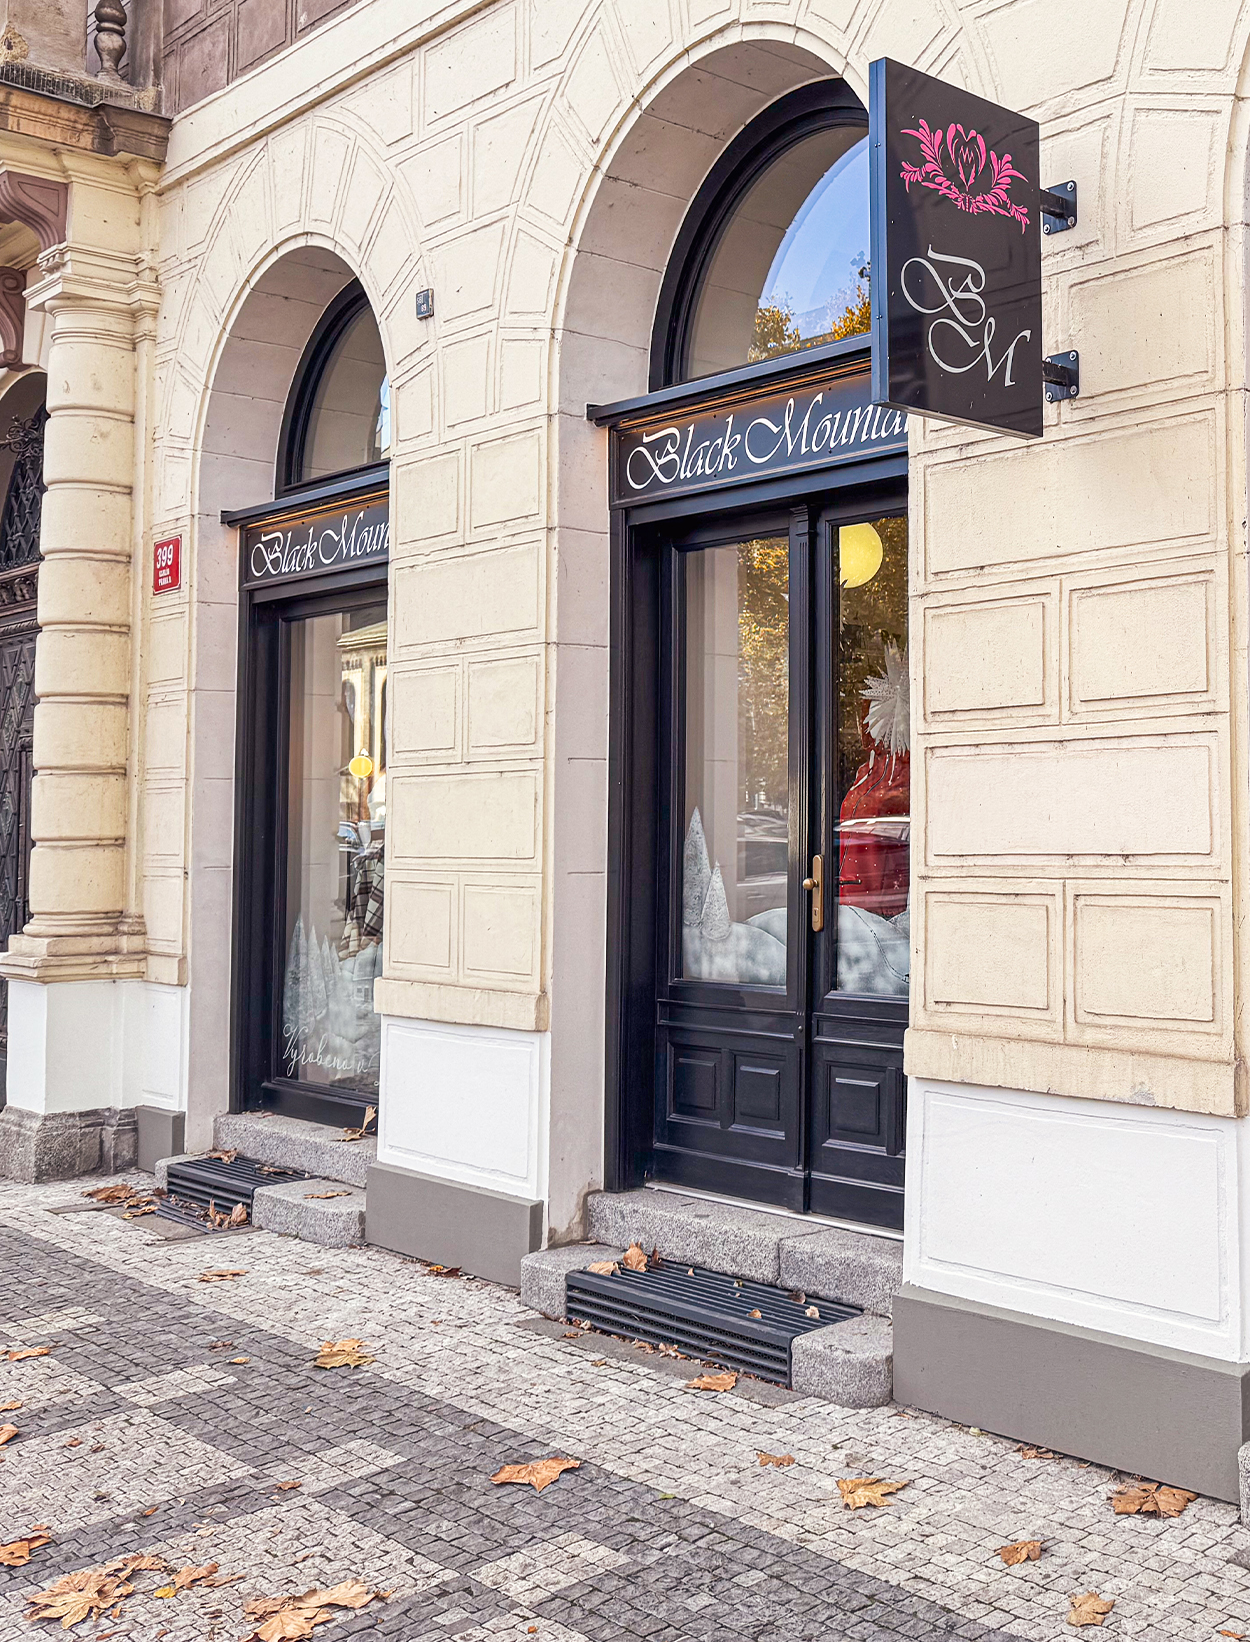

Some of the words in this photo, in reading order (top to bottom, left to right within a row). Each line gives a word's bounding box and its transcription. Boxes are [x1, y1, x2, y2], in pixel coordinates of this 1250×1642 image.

[626, 413, 742, 490] Black
[156, 544, 173, 569] 399
[250, 526, 318, 577] Black
[282, 1023, 352, 1077] Vyrobeno
